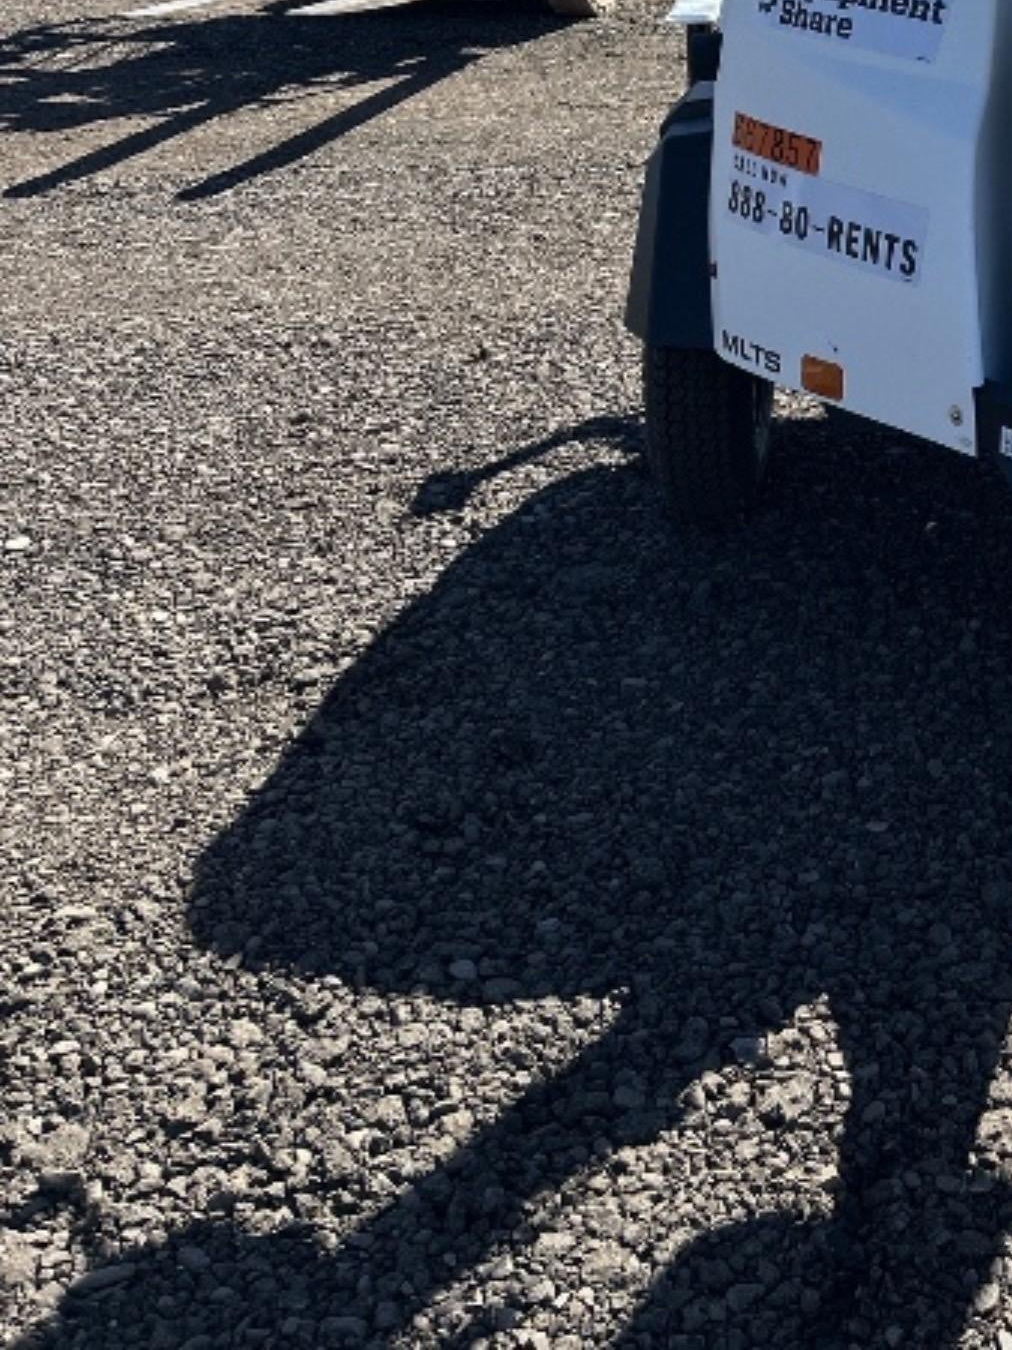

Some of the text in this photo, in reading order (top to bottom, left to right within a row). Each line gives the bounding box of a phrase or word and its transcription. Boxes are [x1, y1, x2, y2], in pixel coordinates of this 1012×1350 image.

[779, 0, 853, 40] Share
[728, 181, 918, 277] 888-80-RENTS
[721, 329, 781, 374] MLTS
